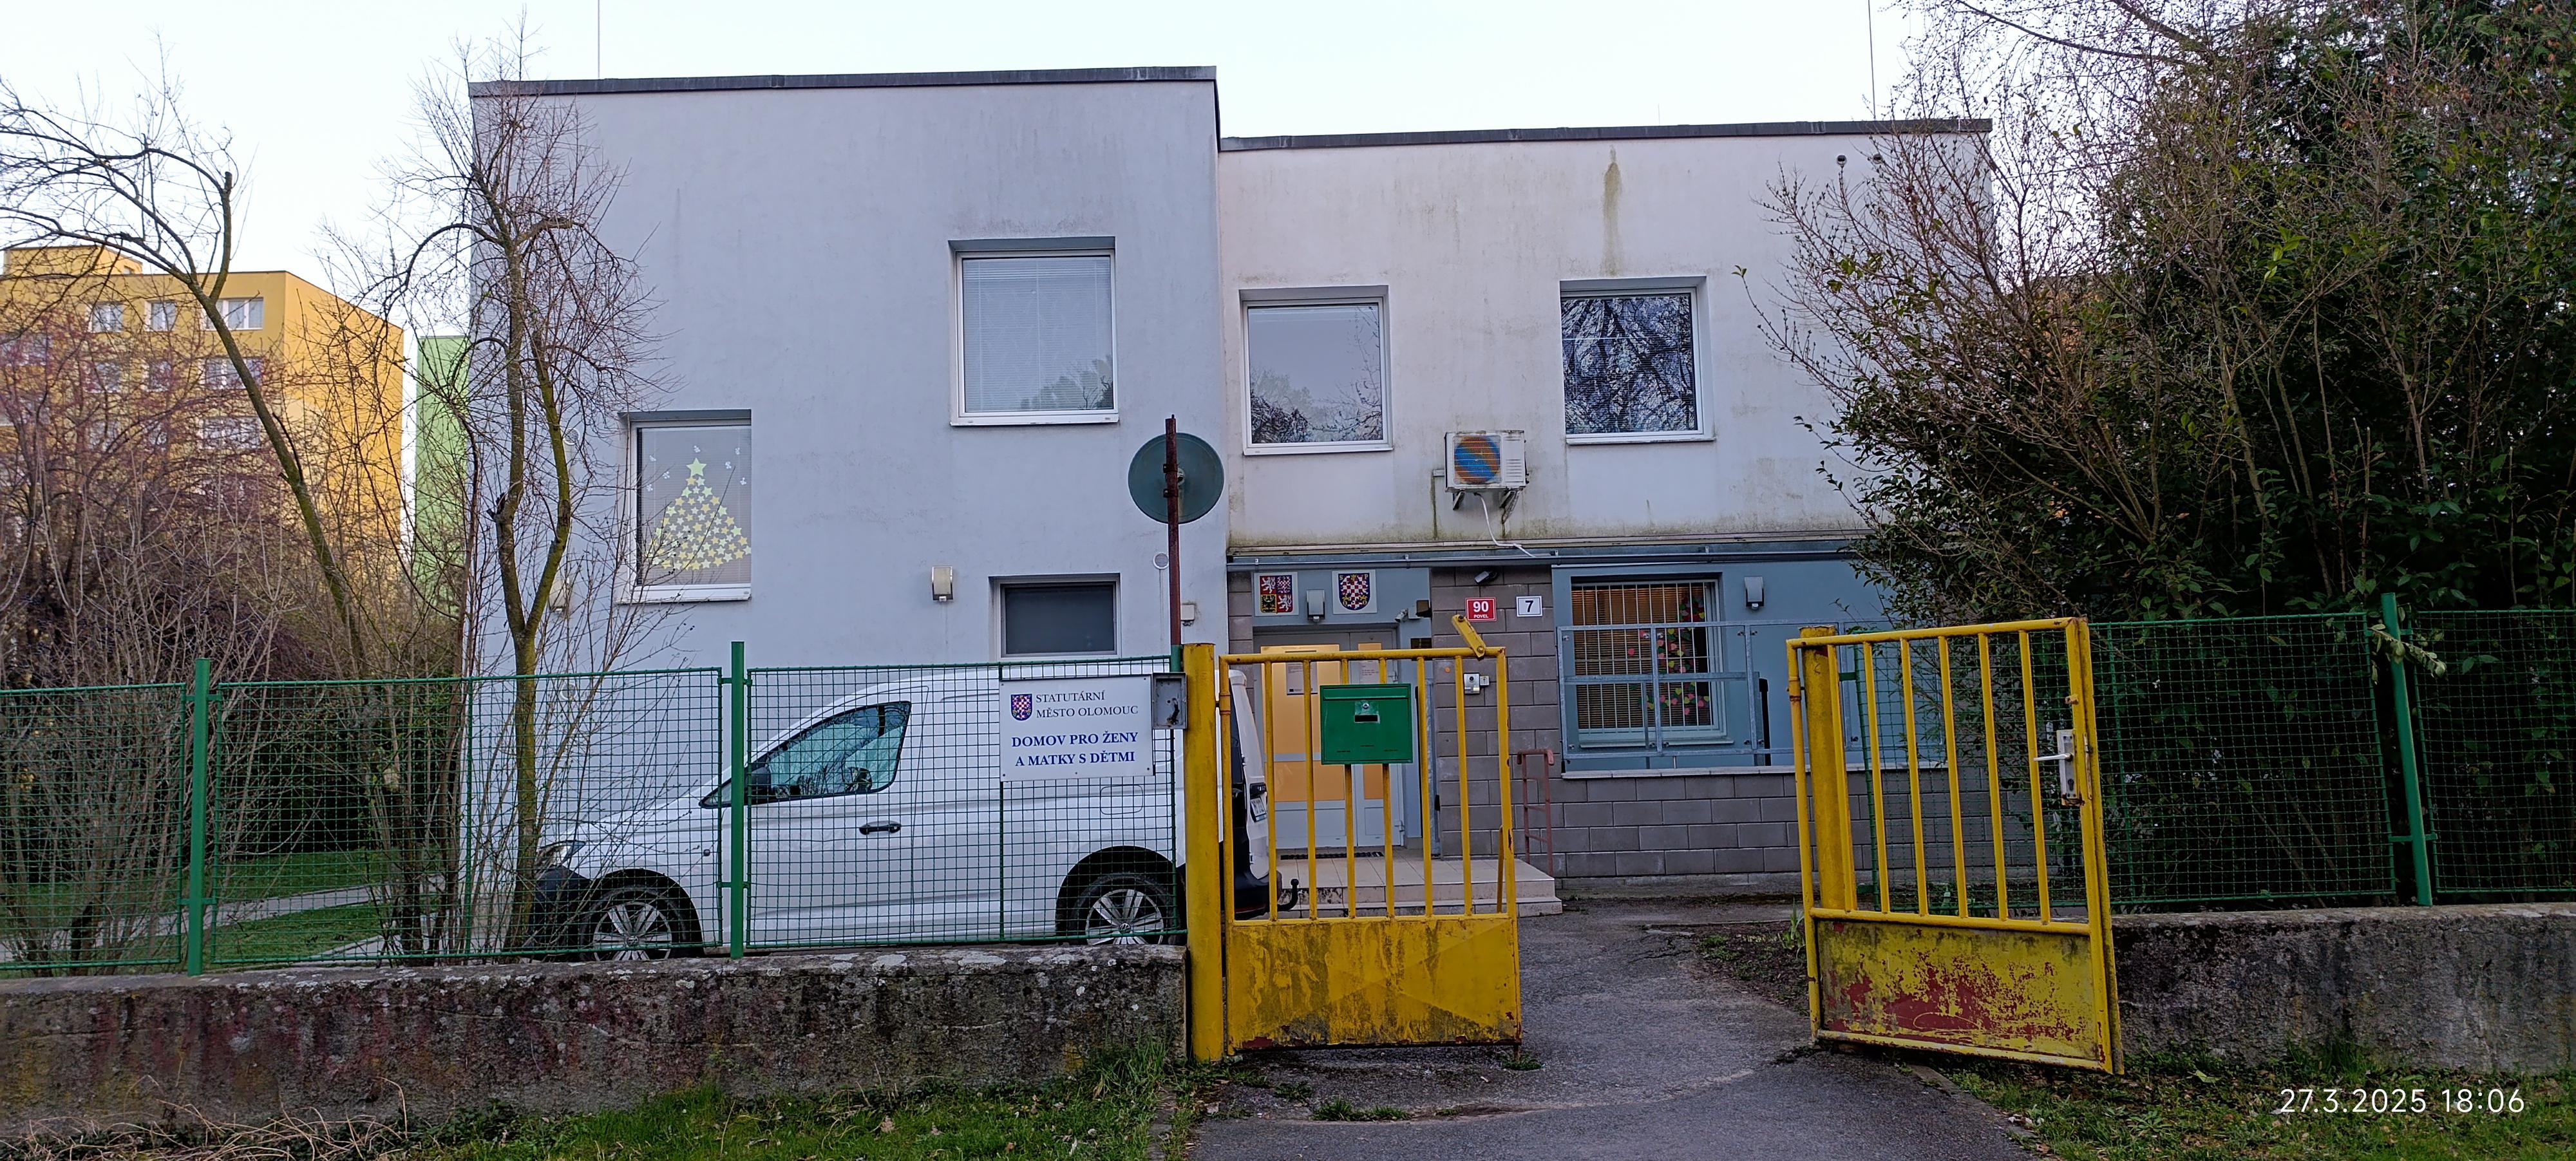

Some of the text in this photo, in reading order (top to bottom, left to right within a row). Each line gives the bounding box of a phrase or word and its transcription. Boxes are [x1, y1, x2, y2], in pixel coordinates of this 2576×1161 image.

[1473, 601, 1489, 612] 90
[1525, 600, 1534, 612] 7
[1036, 690, 1105, 703] STATUTÁRNÍ
[1037, 706, 1139, 718] MĚSTO OLOMOUC
[1012, 730, 1139, 747] DOMOV PRO ŽENY
[1015, 750, 1135, 766] A MATKY S DĚTMI
